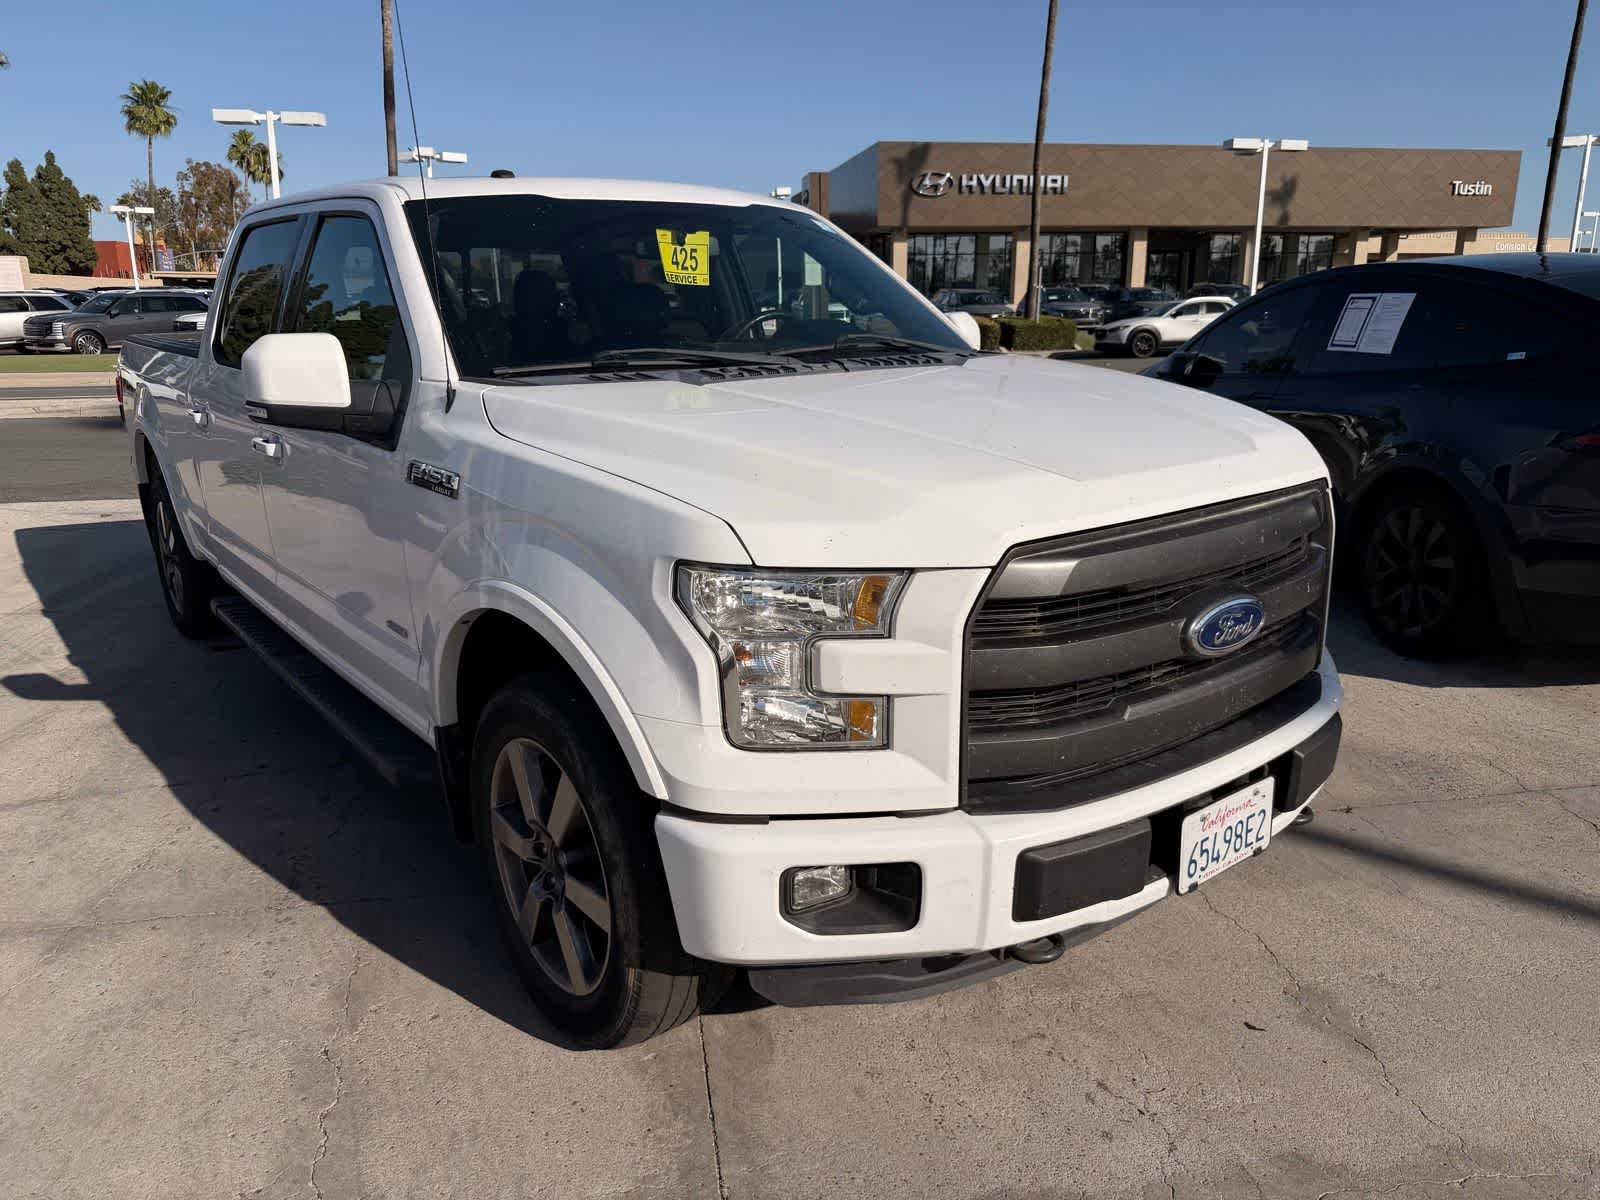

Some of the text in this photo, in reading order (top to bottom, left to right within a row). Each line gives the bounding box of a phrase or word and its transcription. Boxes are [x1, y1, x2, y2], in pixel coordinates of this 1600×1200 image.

[1452, 180, 1493, 196] Tustin
[671, 247, 698, 272] 425
[665, 273, 698, 284] SERVICE
[1214, 611, 1254, 645] Ford
[1200, 799, 1257, 833] California
[1187, 808, 1267, 878] 65498E2
